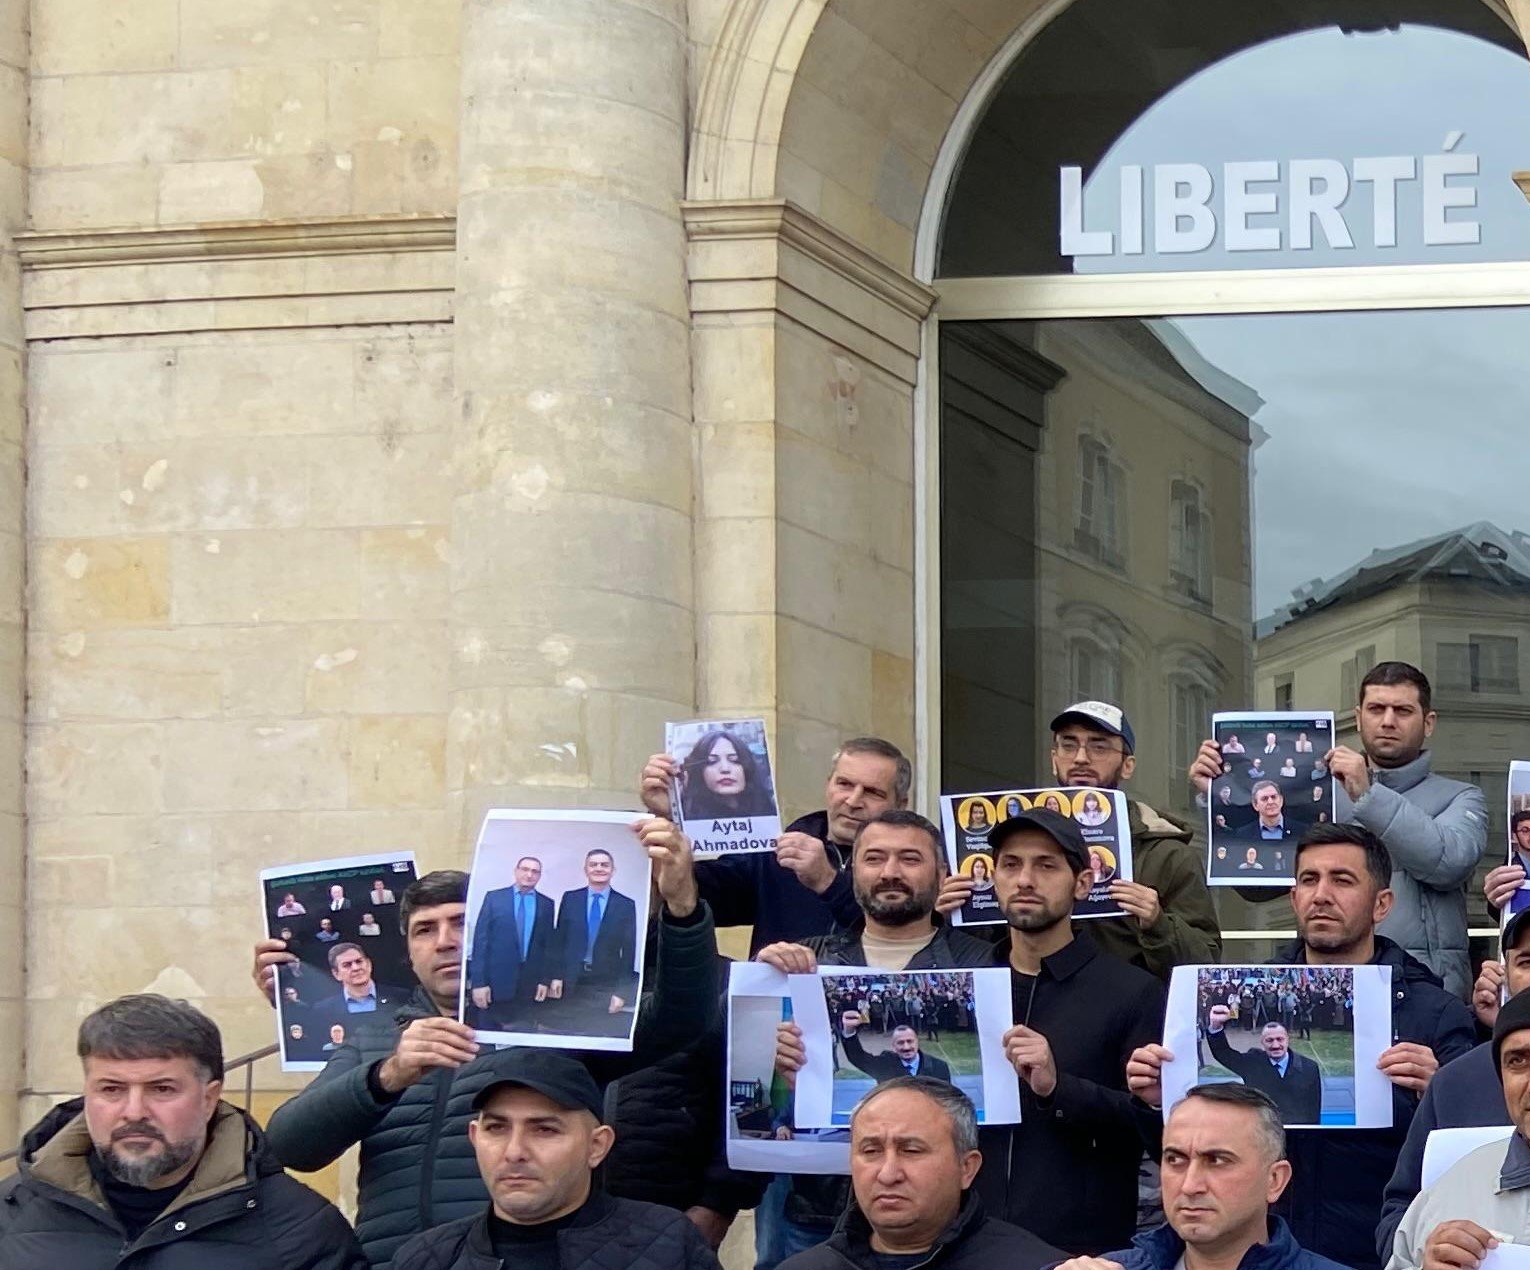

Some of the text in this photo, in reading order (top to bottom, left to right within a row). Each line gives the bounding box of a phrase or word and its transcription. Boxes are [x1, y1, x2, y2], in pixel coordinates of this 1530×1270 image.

[1060, 130, 1482, 256] LIBERTÉ
[712, 819, 752, 835] Aytaj
[693, 838, 777, 852] Ahmadova
